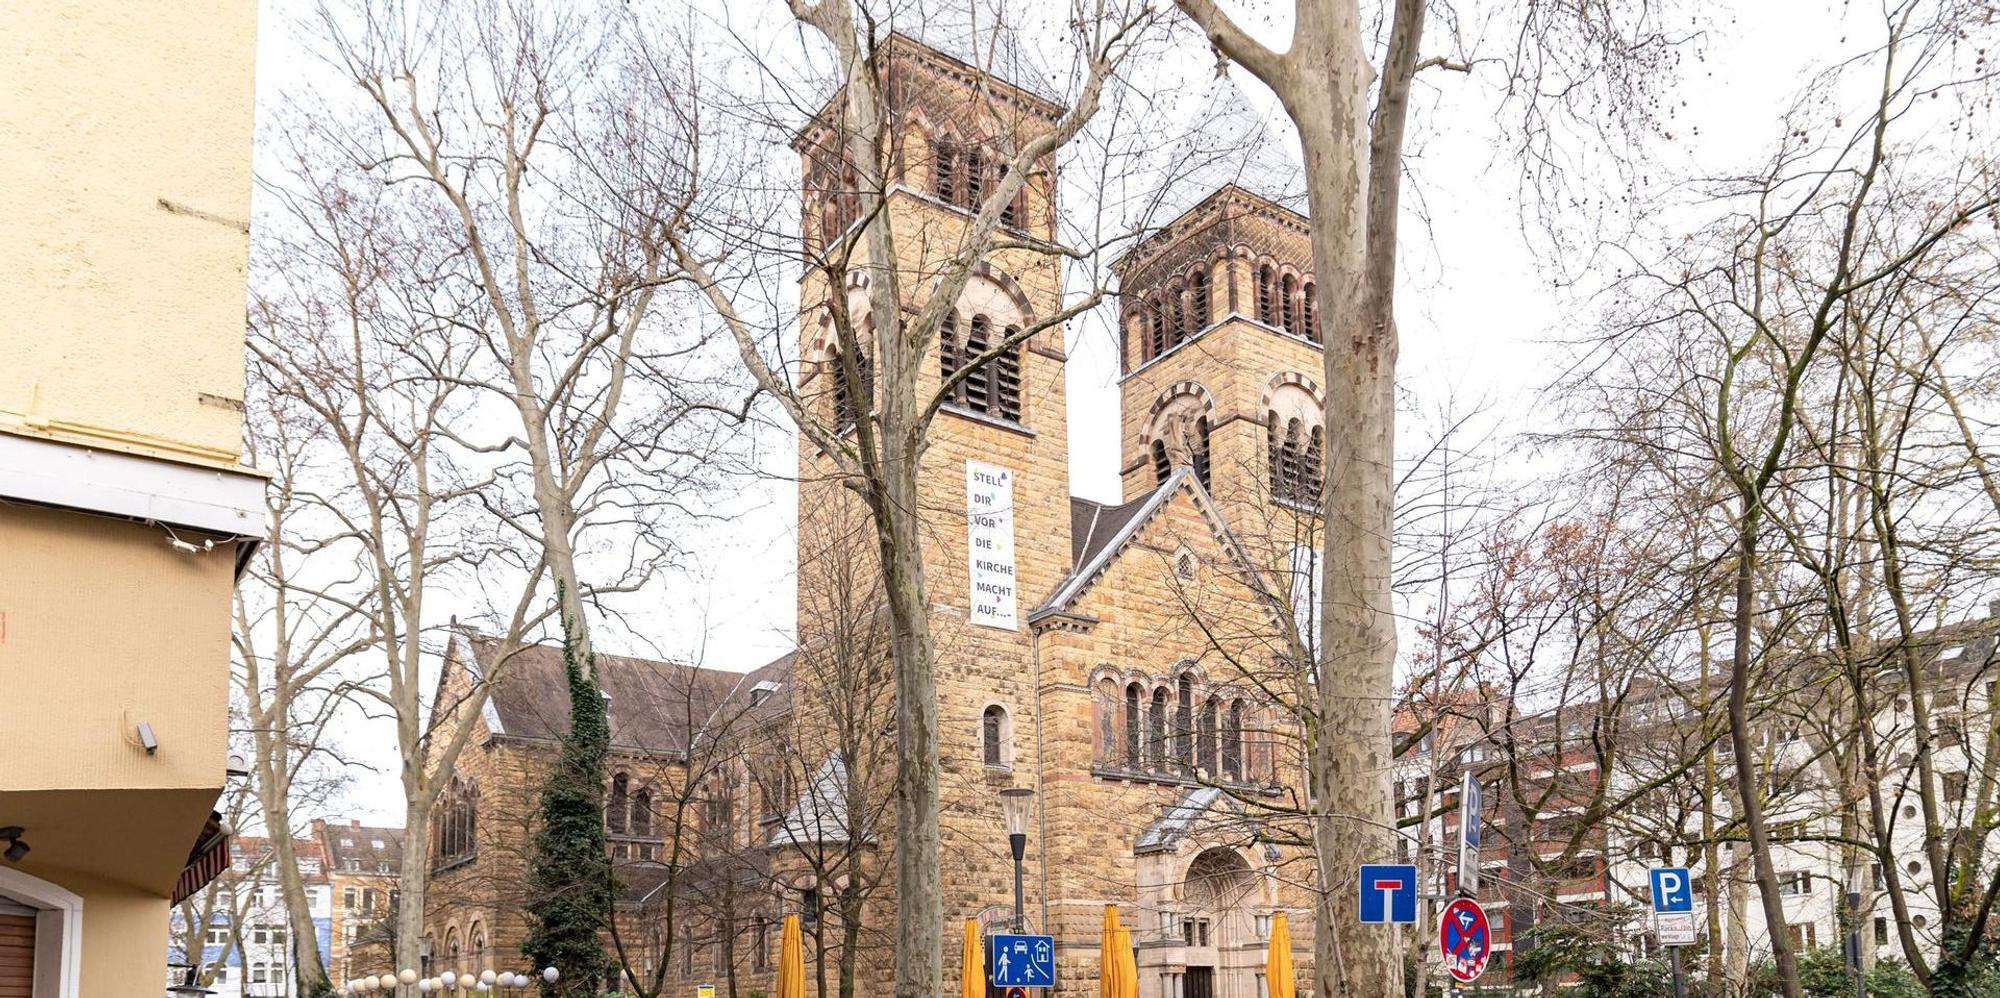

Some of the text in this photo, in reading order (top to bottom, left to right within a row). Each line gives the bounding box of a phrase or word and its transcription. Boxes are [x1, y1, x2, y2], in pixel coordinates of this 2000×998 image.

[974, 472, 1003, 487] STELL
[974, 493, 991, 507] DIR
[974, 515, 995, 529] VOR
[976, 537, 992, 550] DIE
[976, 559, 1013, 575] KIRCHE
[977, 582, 1011, 597] MACHT
[1660, 873, 1681, 906] P
